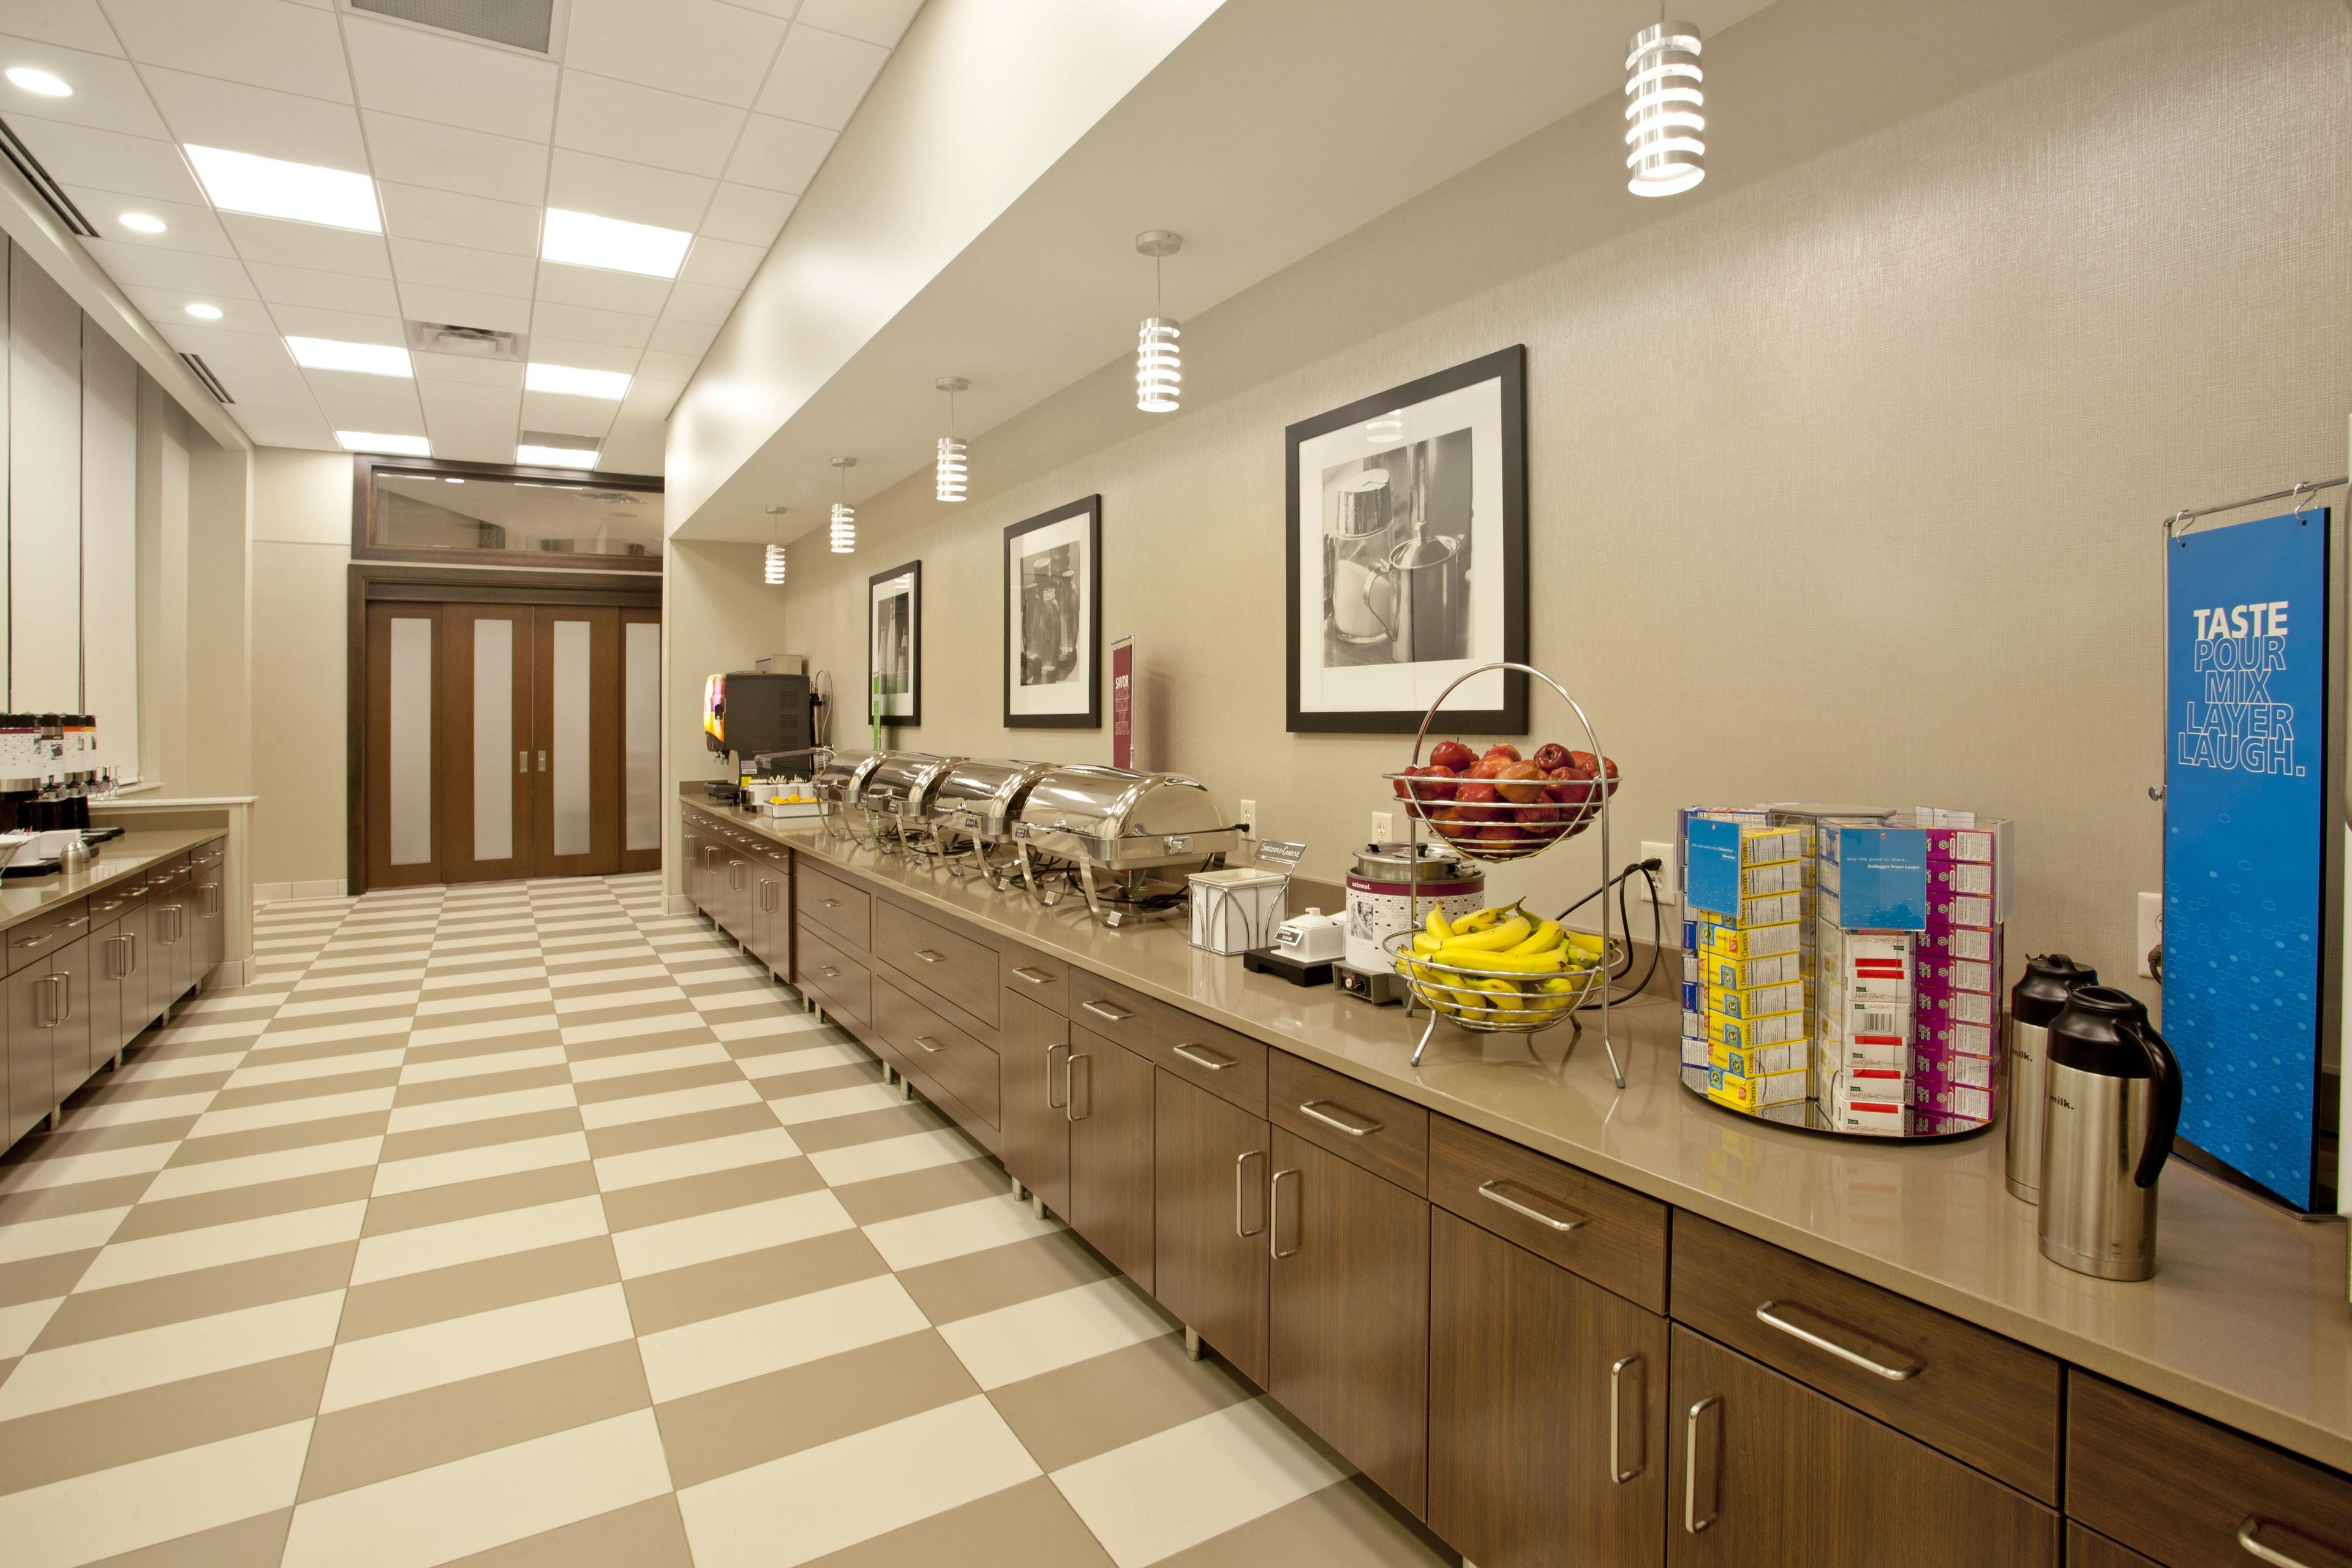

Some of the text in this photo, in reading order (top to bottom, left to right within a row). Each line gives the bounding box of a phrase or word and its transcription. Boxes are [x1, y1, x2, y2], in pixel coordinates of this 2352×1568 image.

[2193, 601, 2288, 640] TASTE
[2195, 635, 2286, 671] POUR
[1115, 674, 1129, 689] SAVOR
[2205, 669, 2272, 704] MIX
[2187, 701, 2294, 740] LAYER
[2178, 732, 2305, 777] LAUGH.
[1260, 843, 1300, 857] SHREDDED CHEESE
[2013, 1049, 2033, 1061] milk.
[2049, 1094, 2074, 1110] milk.
